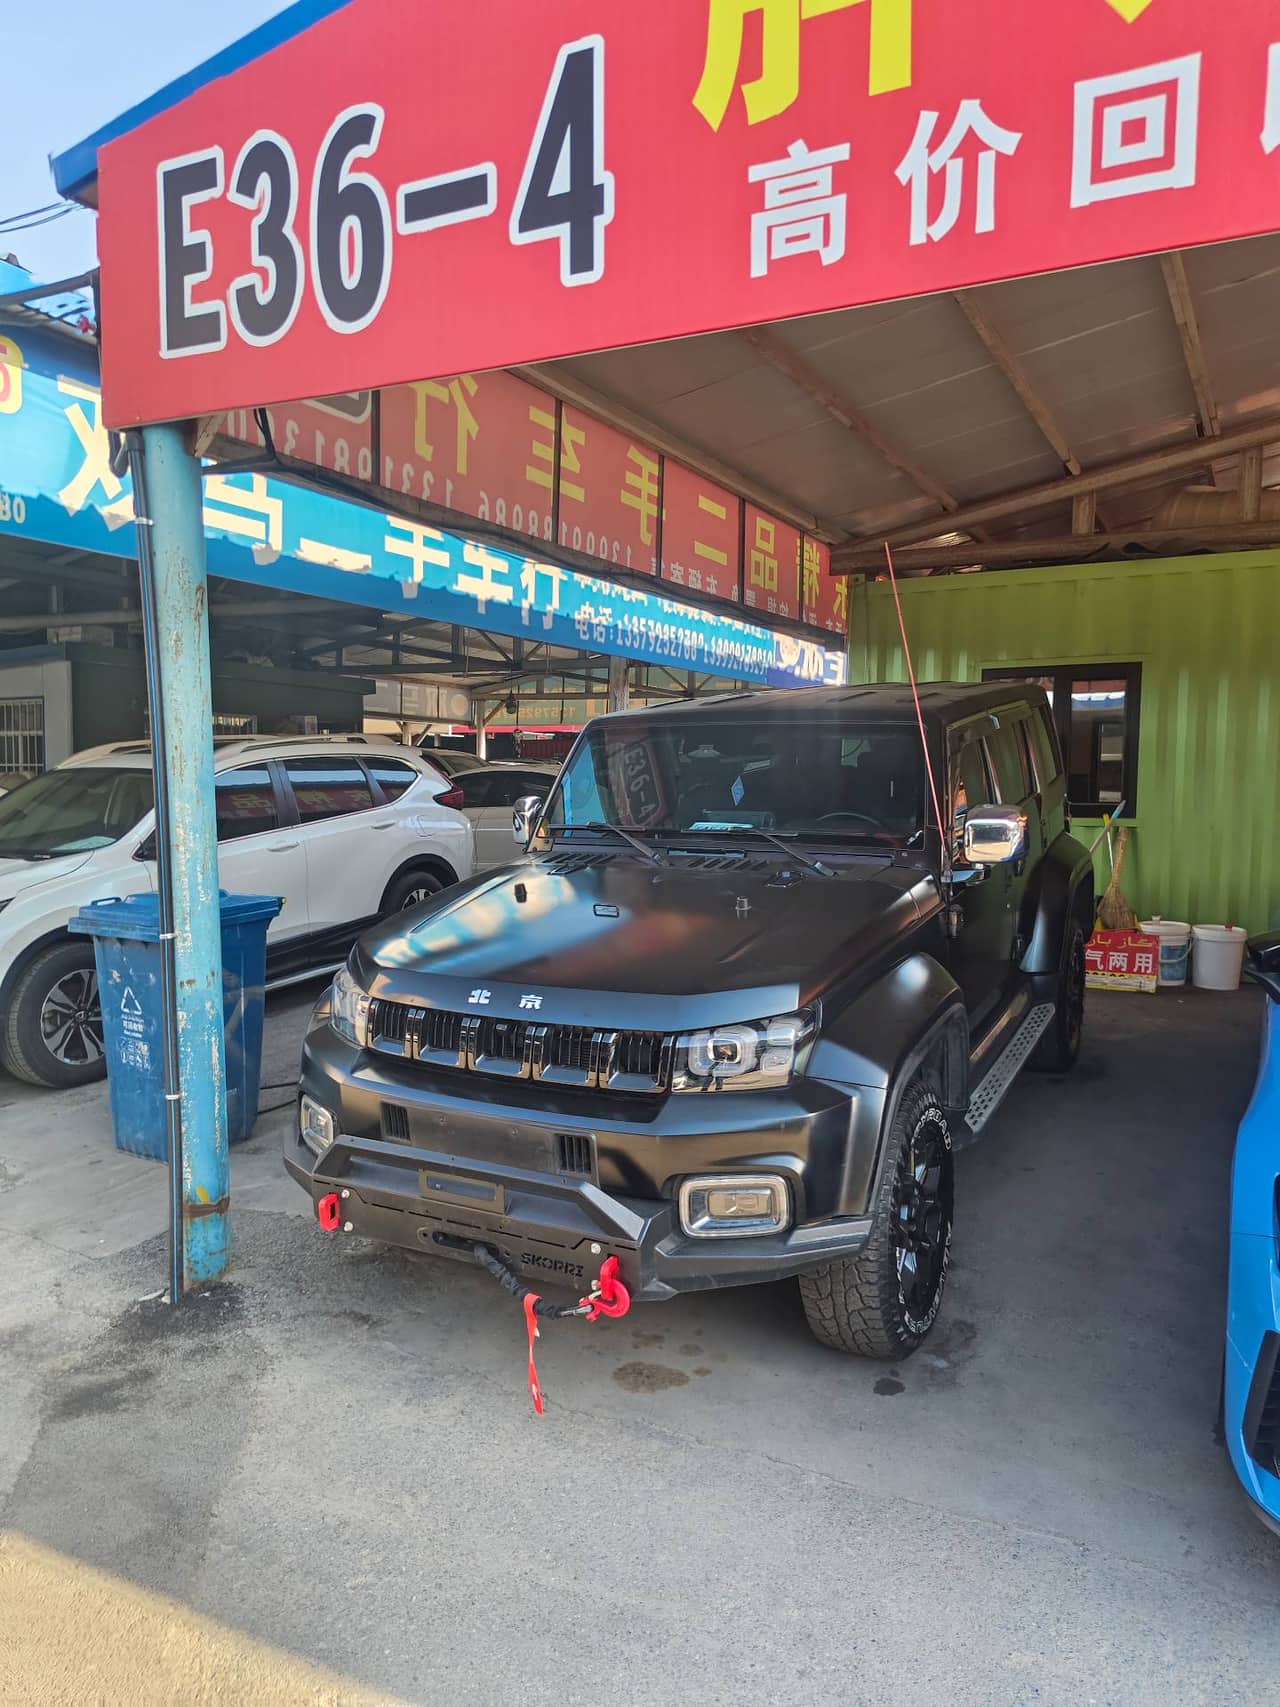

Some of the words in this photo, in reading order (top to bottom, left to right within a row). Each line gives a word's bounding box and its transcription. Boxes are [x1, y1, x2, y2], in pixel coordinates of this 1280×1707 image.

[157, 33, 616, 360] E36-4
[747, 44, 1280, 279] 高价回
[467, 988, 545, 1010] 北京
